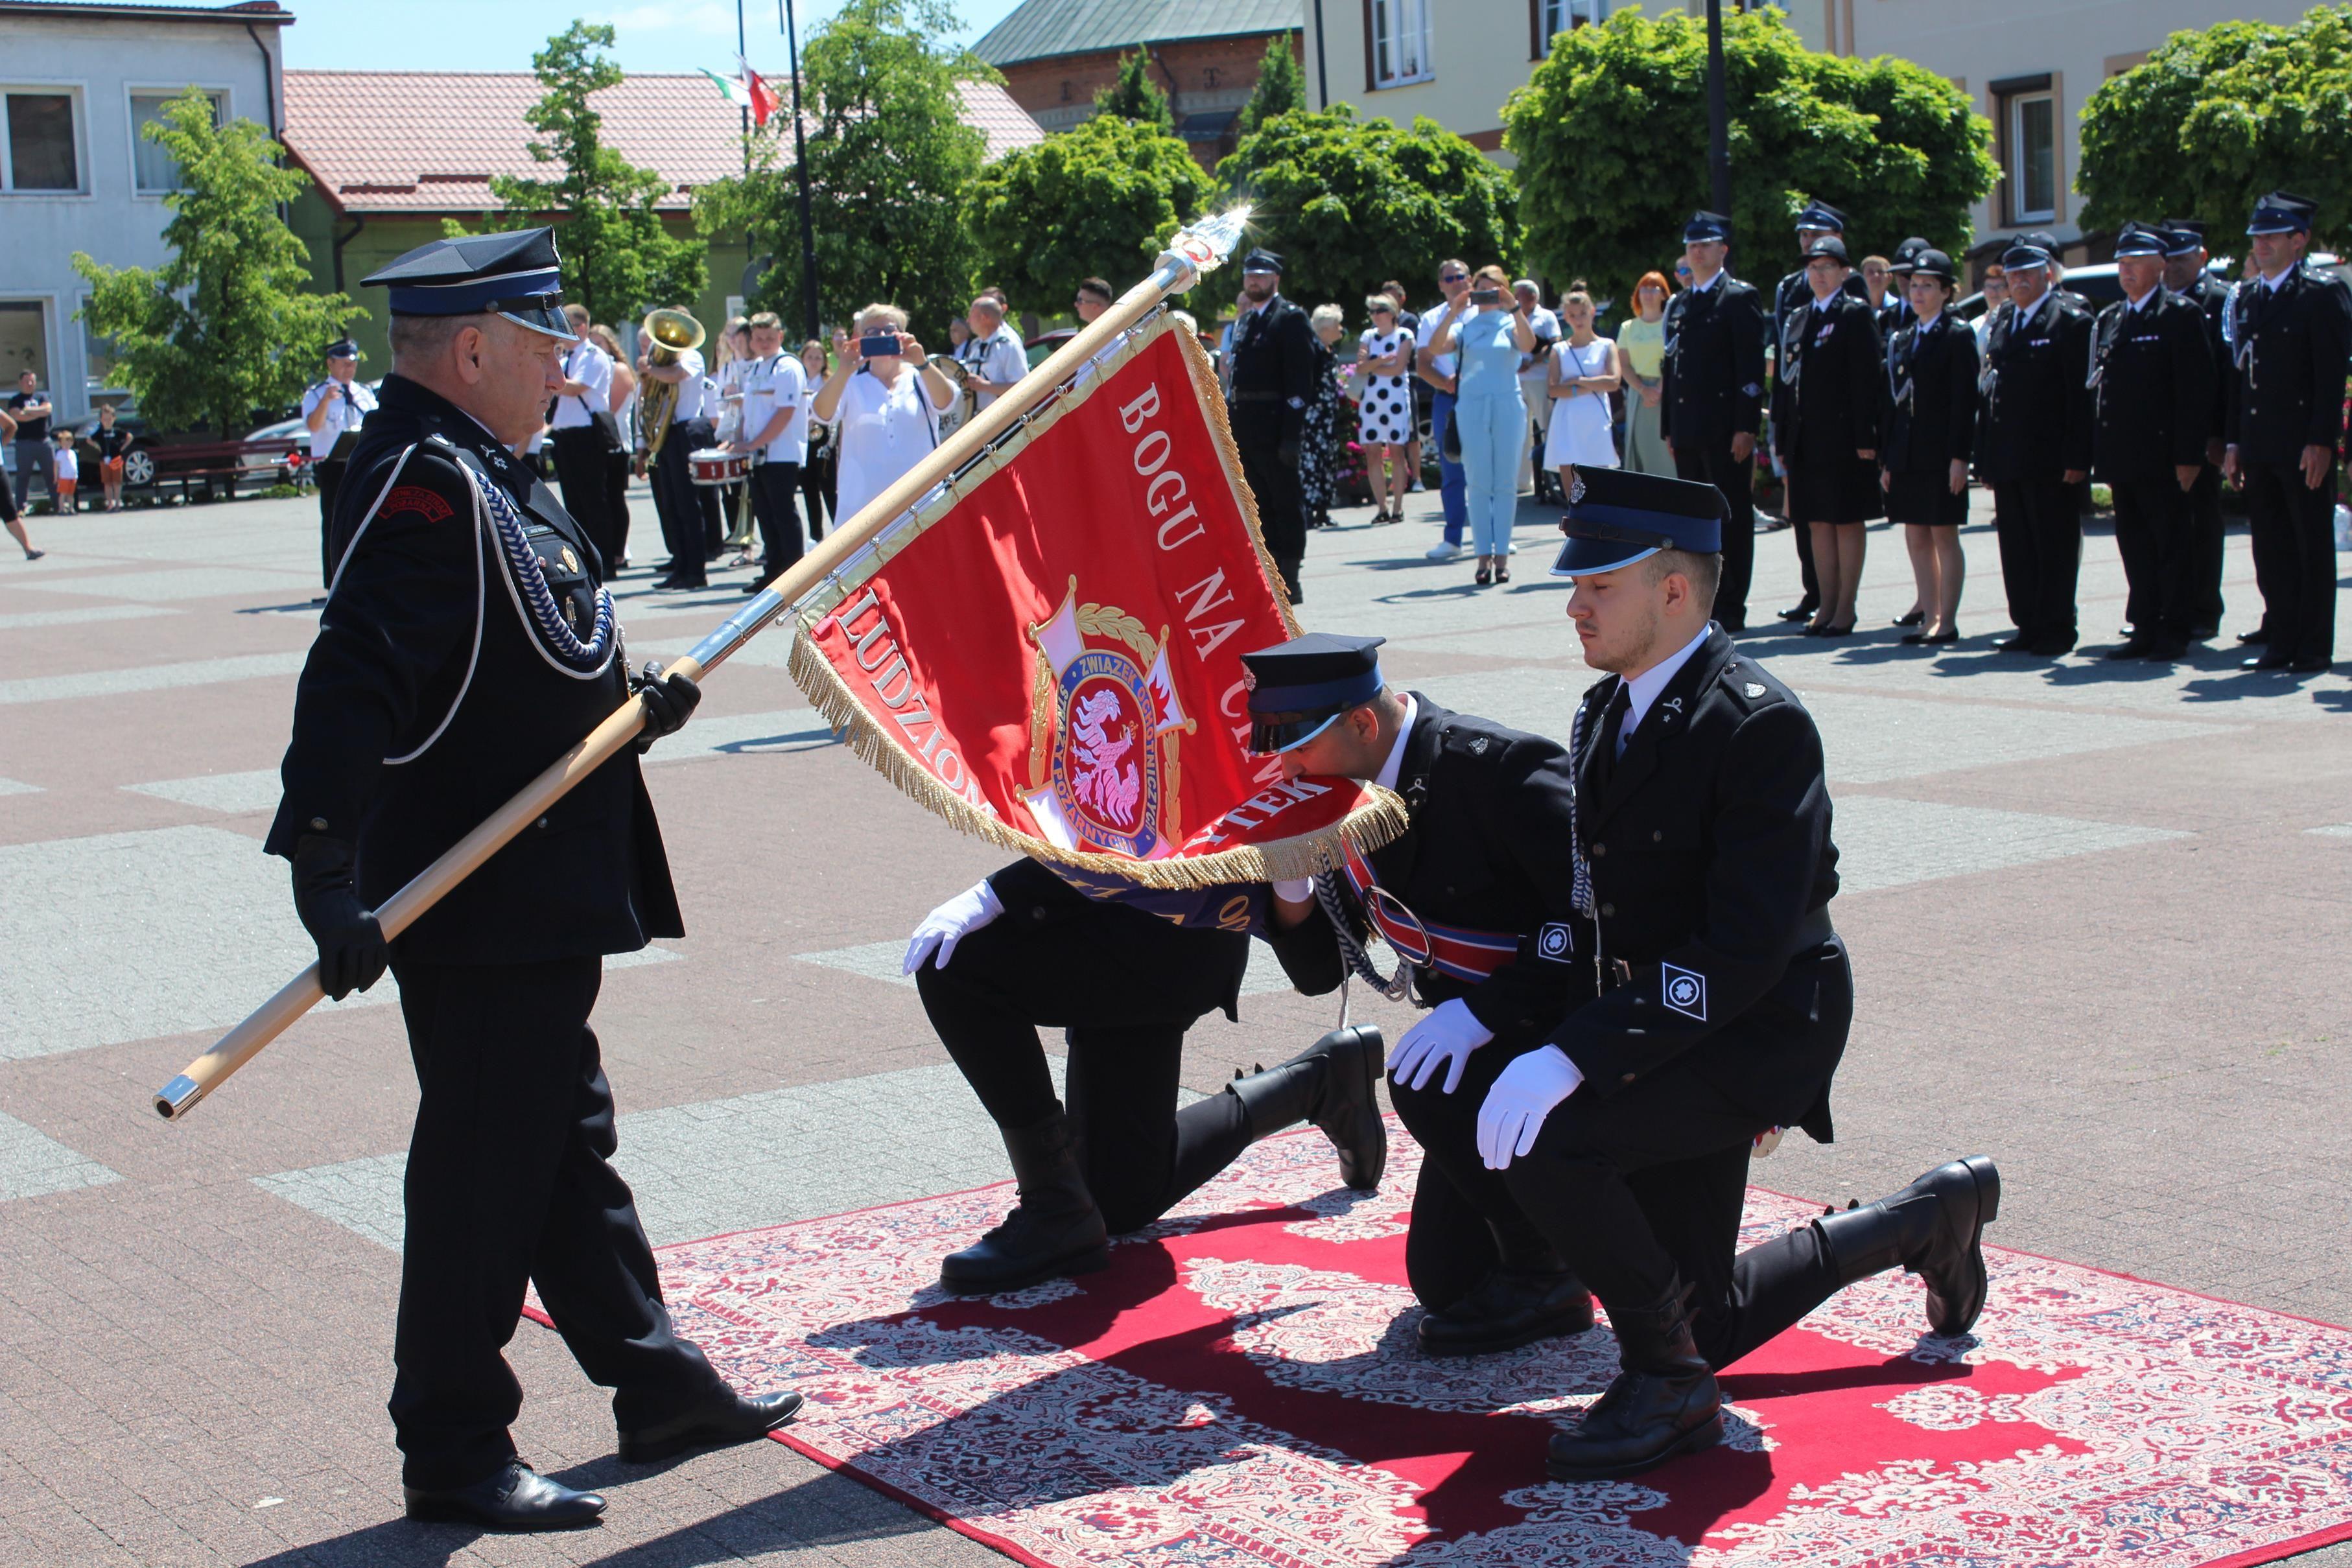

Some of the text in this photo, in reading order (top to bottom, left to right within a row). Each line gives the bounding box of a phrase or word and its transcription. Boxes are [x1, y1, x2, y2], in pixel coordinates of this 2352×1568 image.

[1118, 382, 1206, 551] BOGU
[1175, 567, 1245, 662] NA
[1079, 656, 1158, 836] ZWIĄZEK OCHOTNICZYCH
[1171, 777, 1332, 861] YTEK
